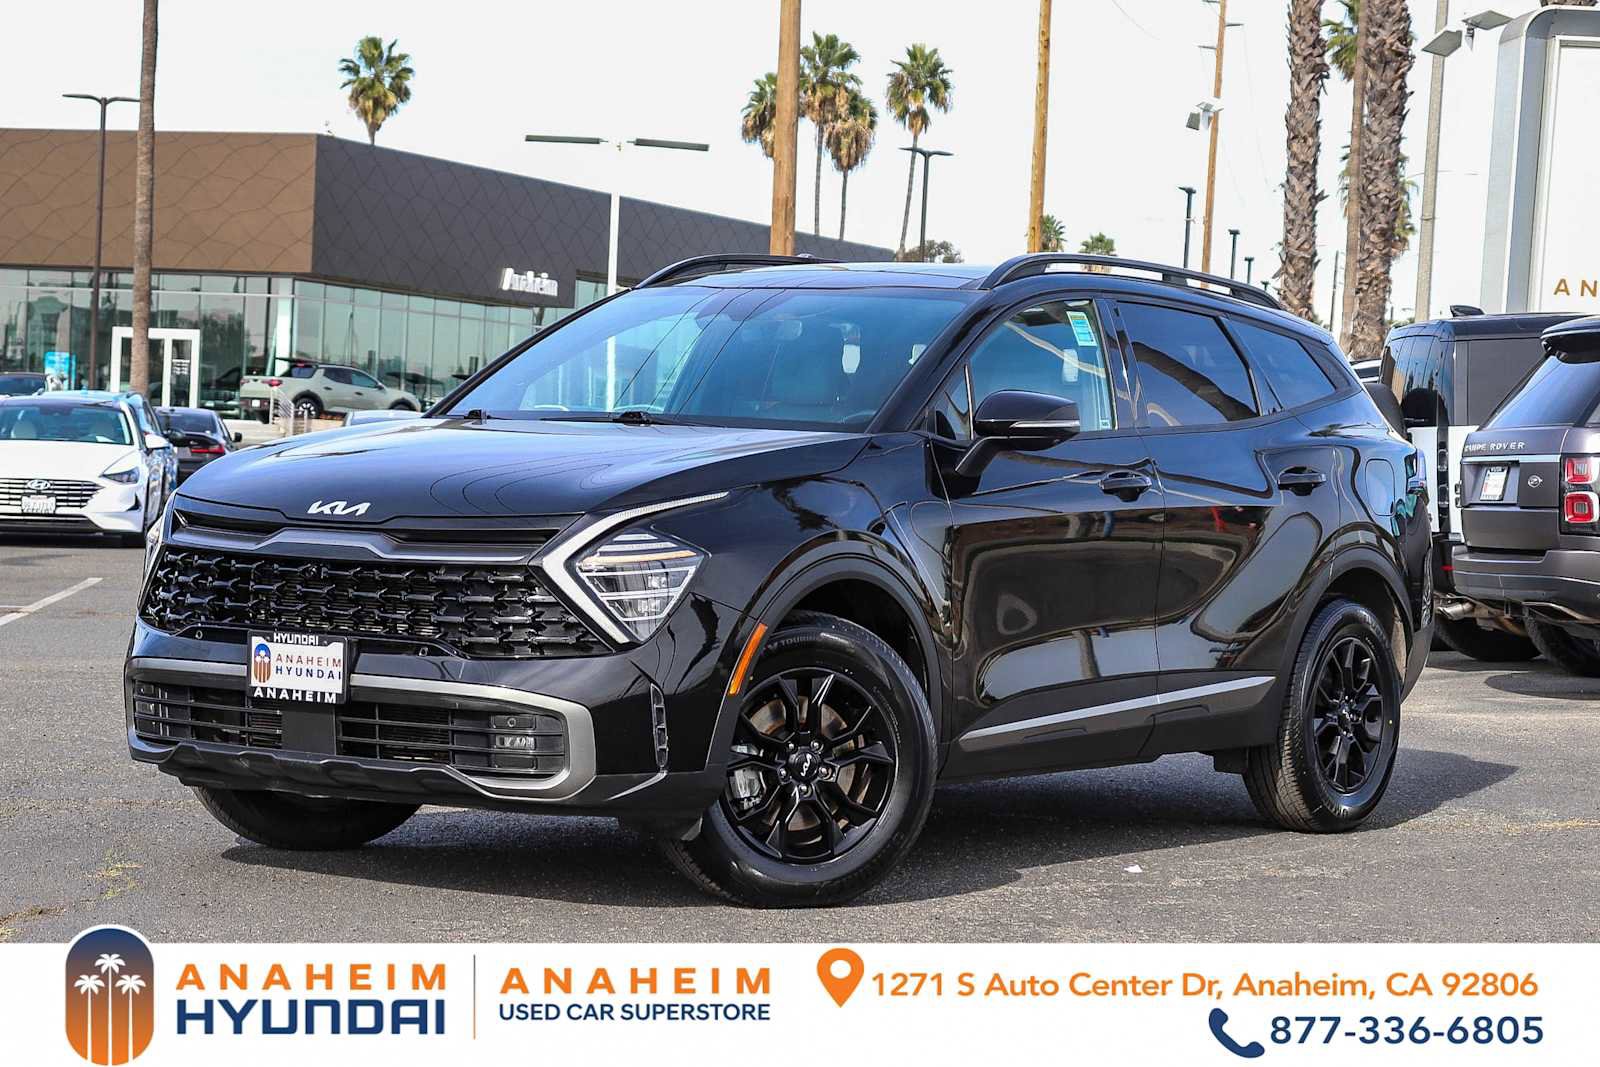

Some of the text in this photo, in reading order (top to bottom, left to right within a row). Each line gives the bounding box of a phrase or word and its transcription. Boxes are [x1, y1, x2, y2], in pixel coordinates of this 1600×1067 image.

[1489, 441, 1525, 450] ROVER
[274, 632, 319, 646] HYUNDAI
[275, 654, 342, 668] ANAHEIM
[275, 665, 342, 680] HYUNDAI
[253, 686, 337, 704] ANAHEIM
